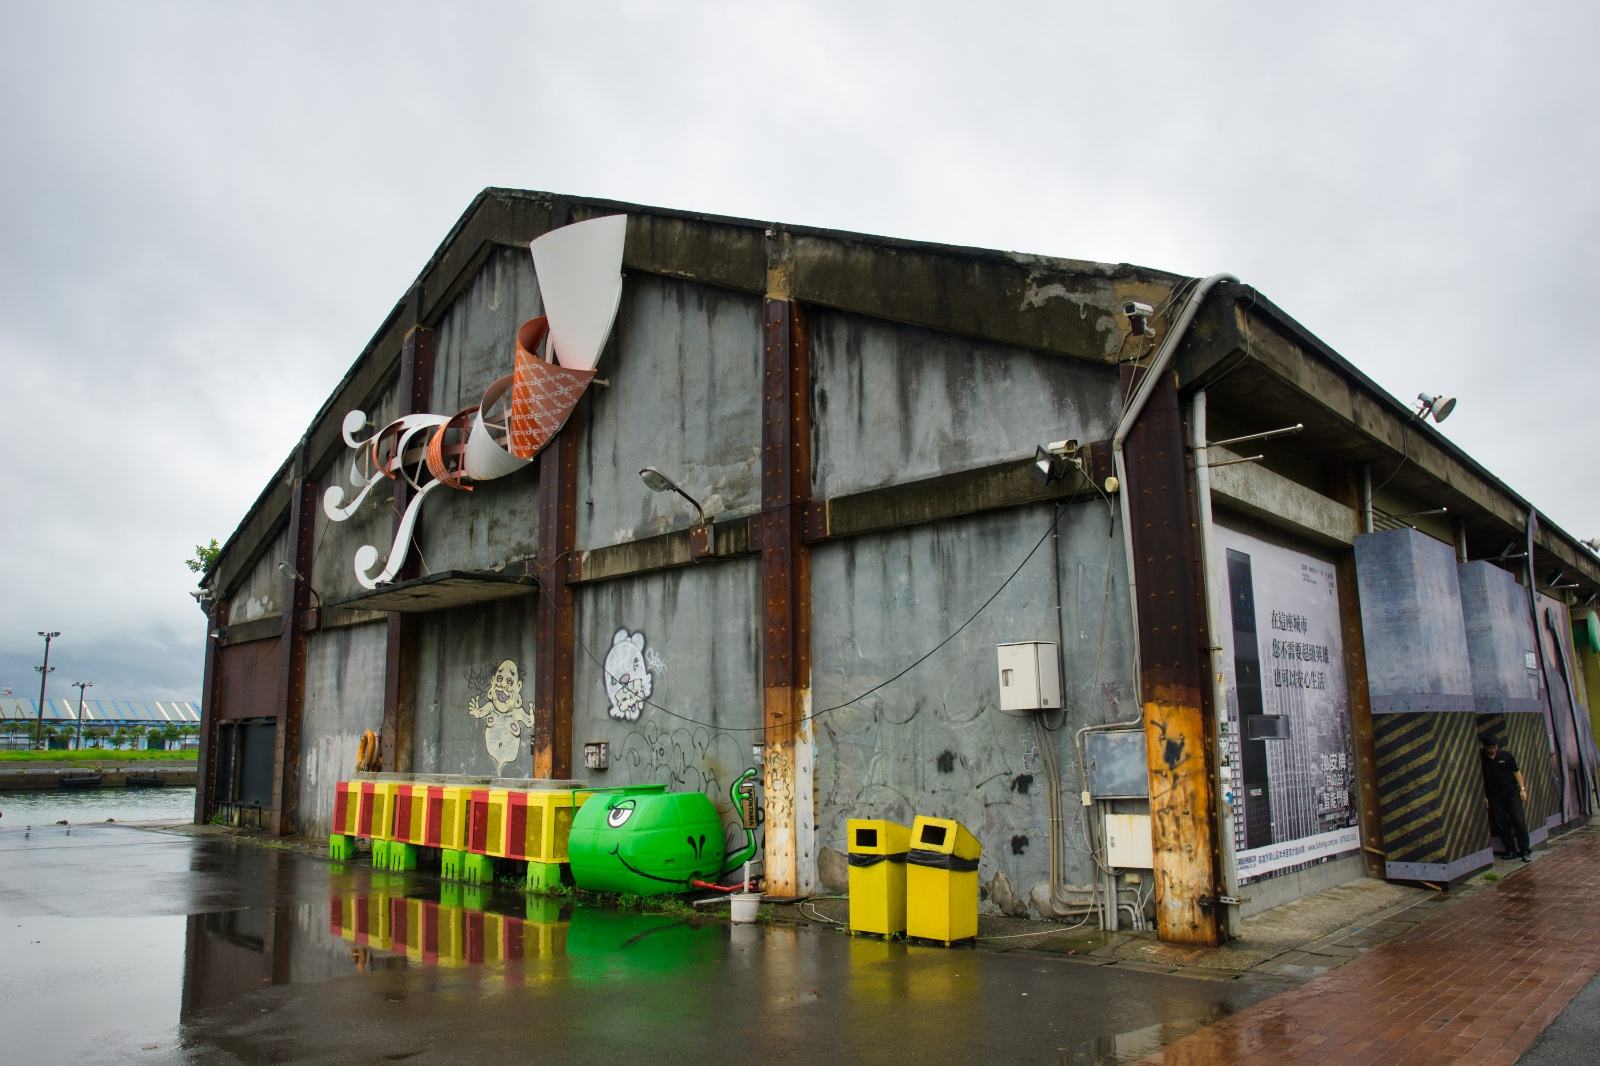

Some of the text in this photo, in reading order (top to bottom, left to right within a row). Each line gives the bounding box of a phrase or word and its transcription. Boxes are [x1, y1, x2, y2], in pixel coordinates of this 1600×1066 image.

[1270, 609, 1308, 635] 在這座城市
[1272, 638, 1330, 664] 您不需要超級英雄
[1273, 667, 1325, 690] 也可以安心生活
[1323, 790, 1350, 810] 智能門鎖
